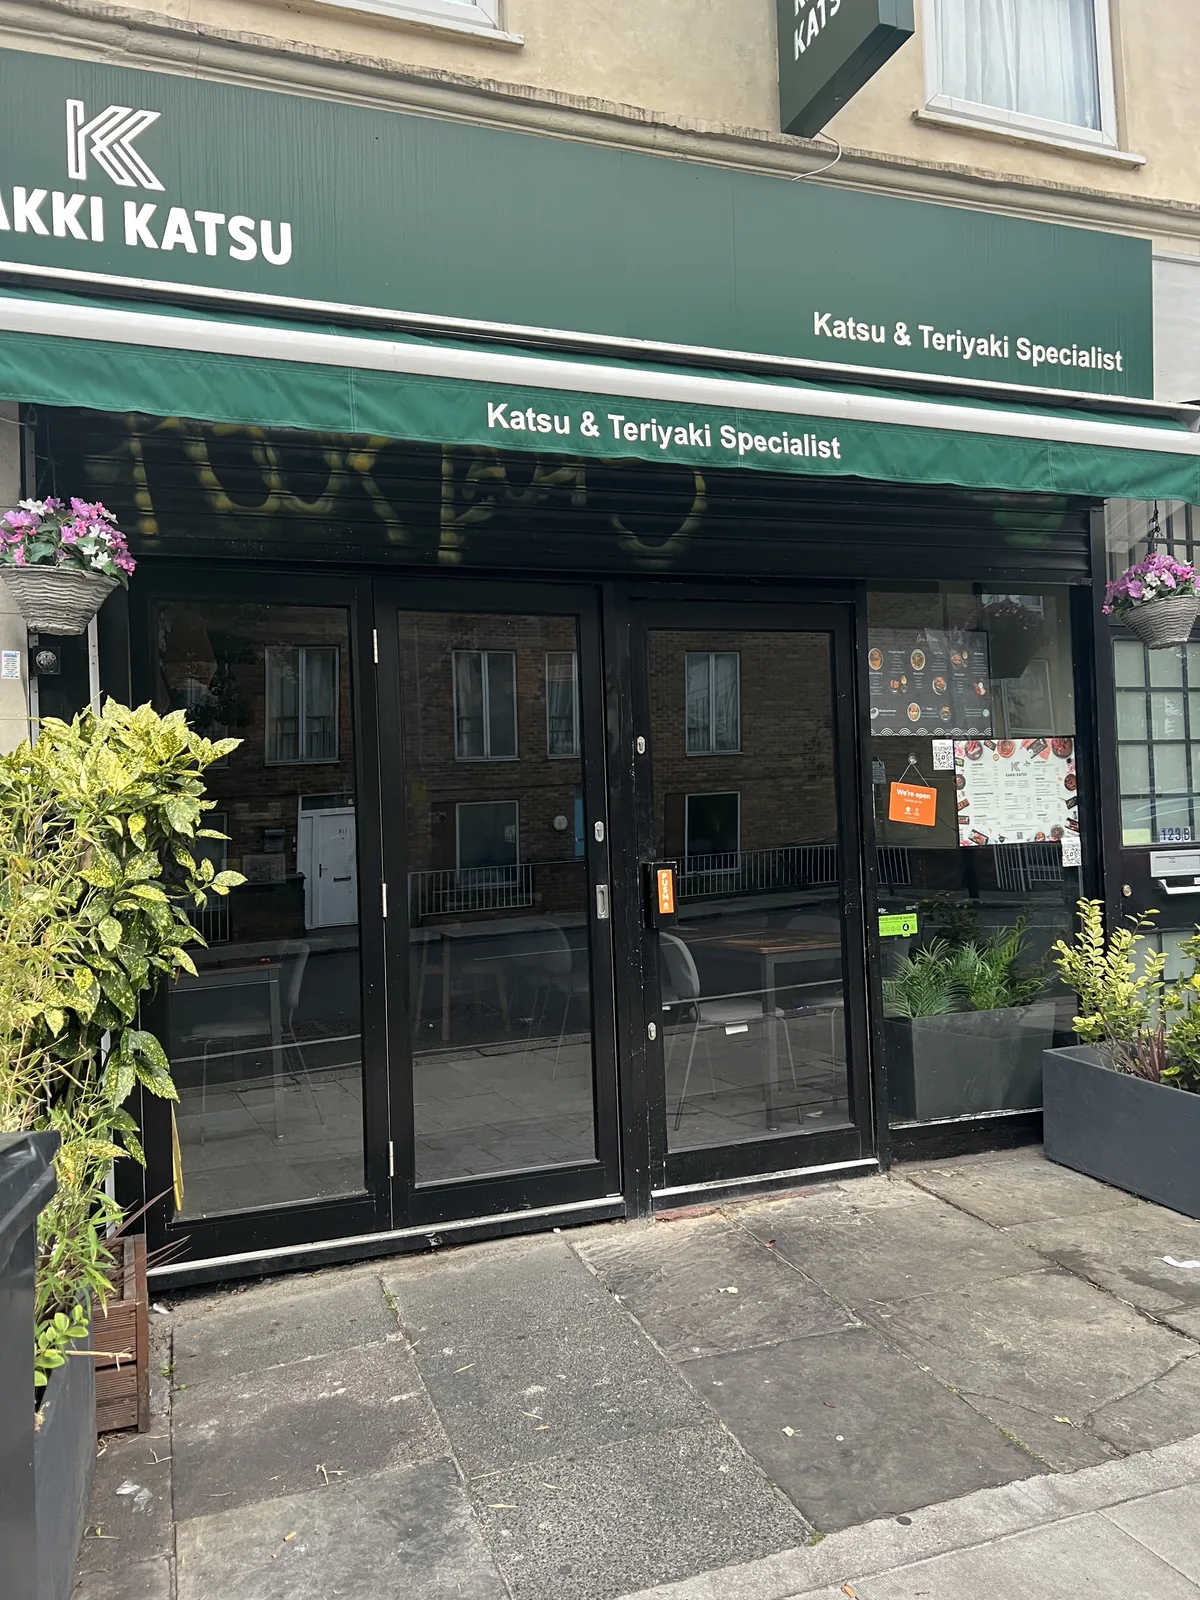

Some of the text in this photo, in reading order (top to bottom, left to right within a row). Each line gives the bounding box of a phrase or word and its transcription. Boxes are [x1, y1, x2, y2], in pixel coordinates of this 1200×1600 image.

[0, 186, 293, 266] KKI KATSU
[813, 311, 1123, 372] Katsu & Teriyaki Specialist
[487, 402, 842, 460] Katsu & Teriyaki Specialist
[896, 788, 931, 800] We're open
[661, 872, 669, 900] PUSH
